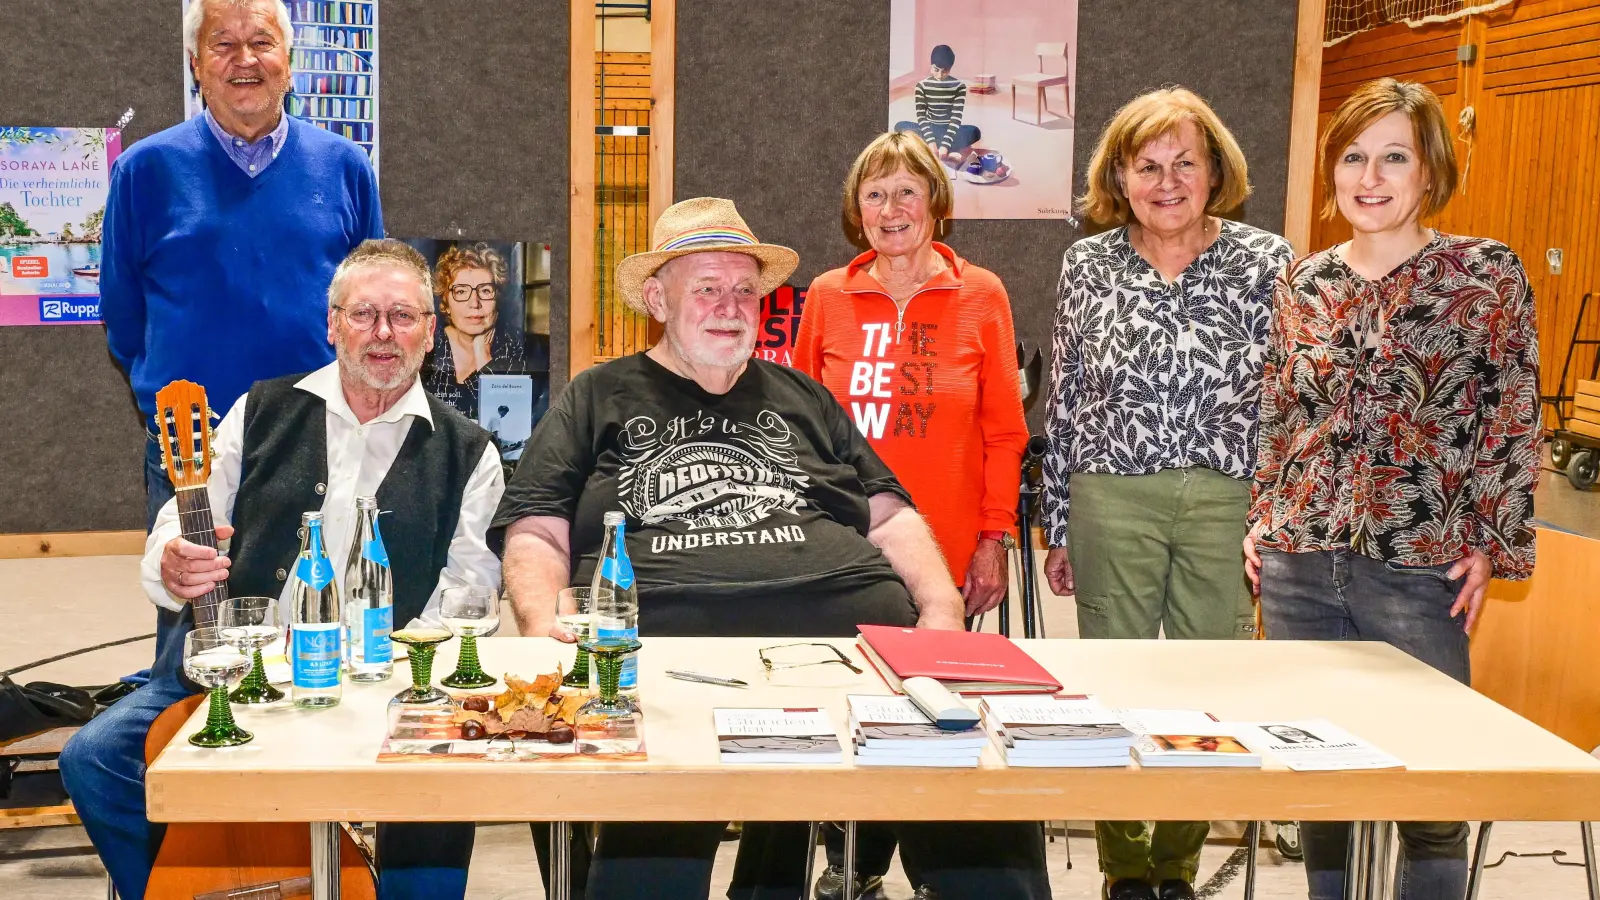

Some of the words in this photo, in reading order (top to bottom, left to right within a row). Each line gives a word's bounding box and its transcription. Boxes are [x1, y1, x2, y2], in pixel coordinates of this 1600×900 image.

[1, 160, 57, 171] SORAYA
[62, 160, 99, 171] LANE
[0, 177, 19, 189] Die
[22, 177, 102, 189] verheimlichte
[20, 190, 83, 207] Tochter
[850, 361, 938, 398] BEST
[851, 402, 936, 440] WAY
[651, 525, 806, 554] UNDERSTAND
